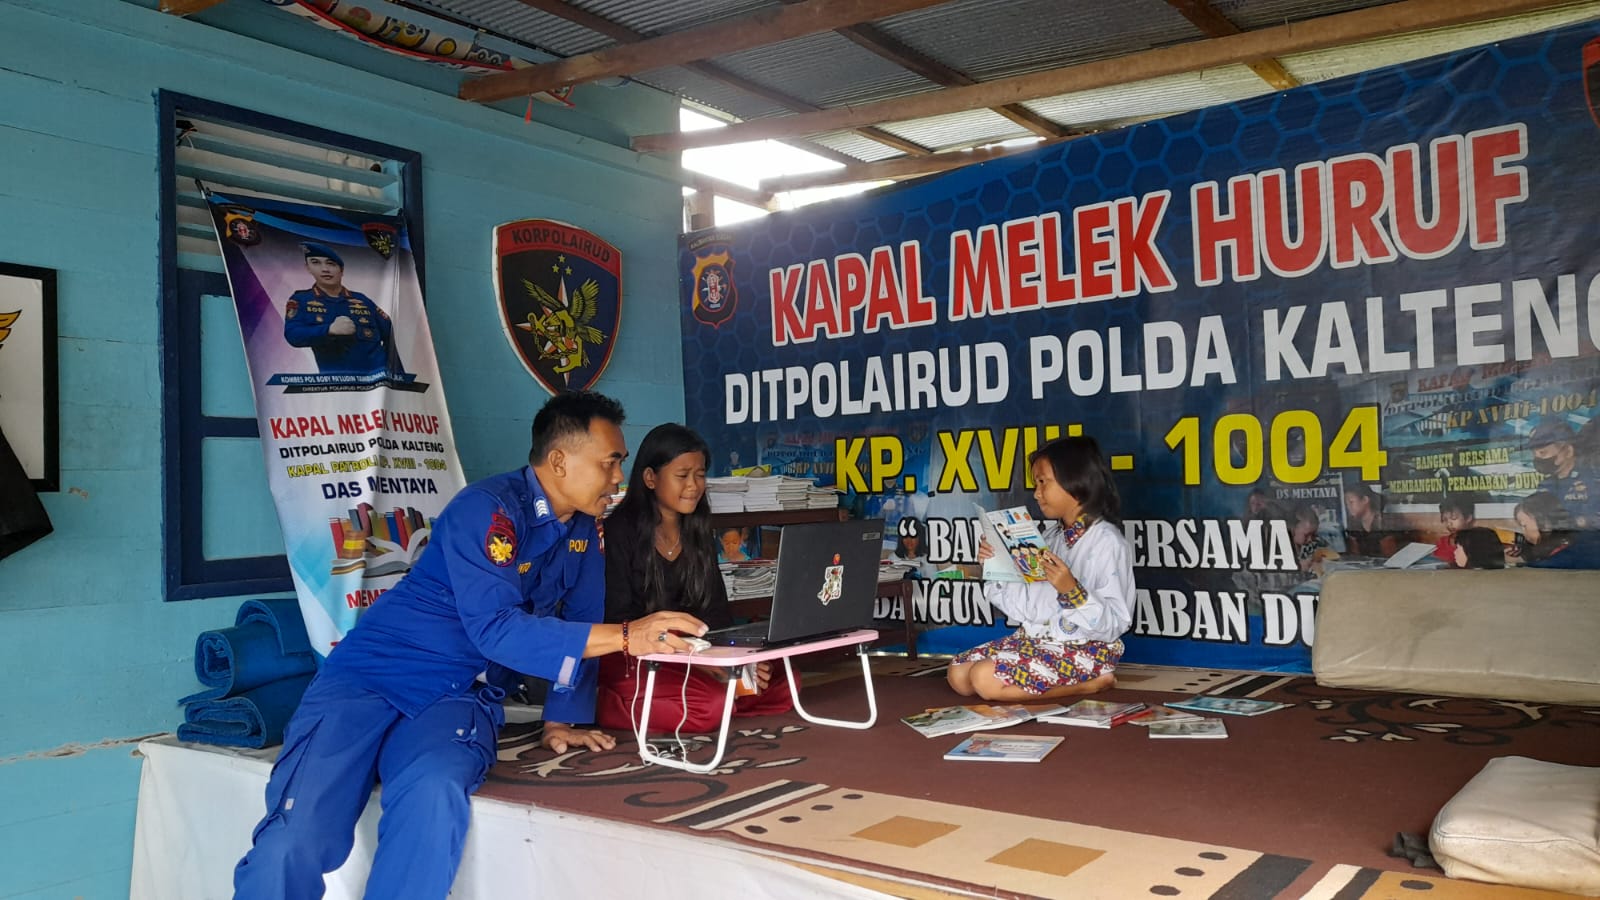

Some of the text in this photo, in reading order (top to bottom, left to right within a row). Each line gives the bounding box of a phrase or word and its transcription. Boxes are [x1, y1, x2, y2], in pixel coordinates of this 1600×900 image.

[511, 228, 611, 264] KORPOLAIRUD
[770, 122, 1529, 347] KAPAL MELEK HURUF
[724, 272, 1600, 425] DITPOLAIRUD POLDA KALTEN
[270, 408, 441, 440] KAPAL MELEK HURUF
[279, 436, 445, 459] DITPOLAIRUD POLDA KALTENG
[835, 434, 916, 493] KP.
[937, 423, 1084, 493] XVI
[1163, 406, 1388, 486] 1004
[287, 463, 330, 478] KAPAL
[331, 454, 378, 474] PATROLI
[1448, 472, 1510, 492] PERADABAN
[321, 475, 439, 500] DAS MENTAYA
[1292, 487, 1339, 499] MENTAYA
[1121, 518, 1299, 571] ERSAMA
